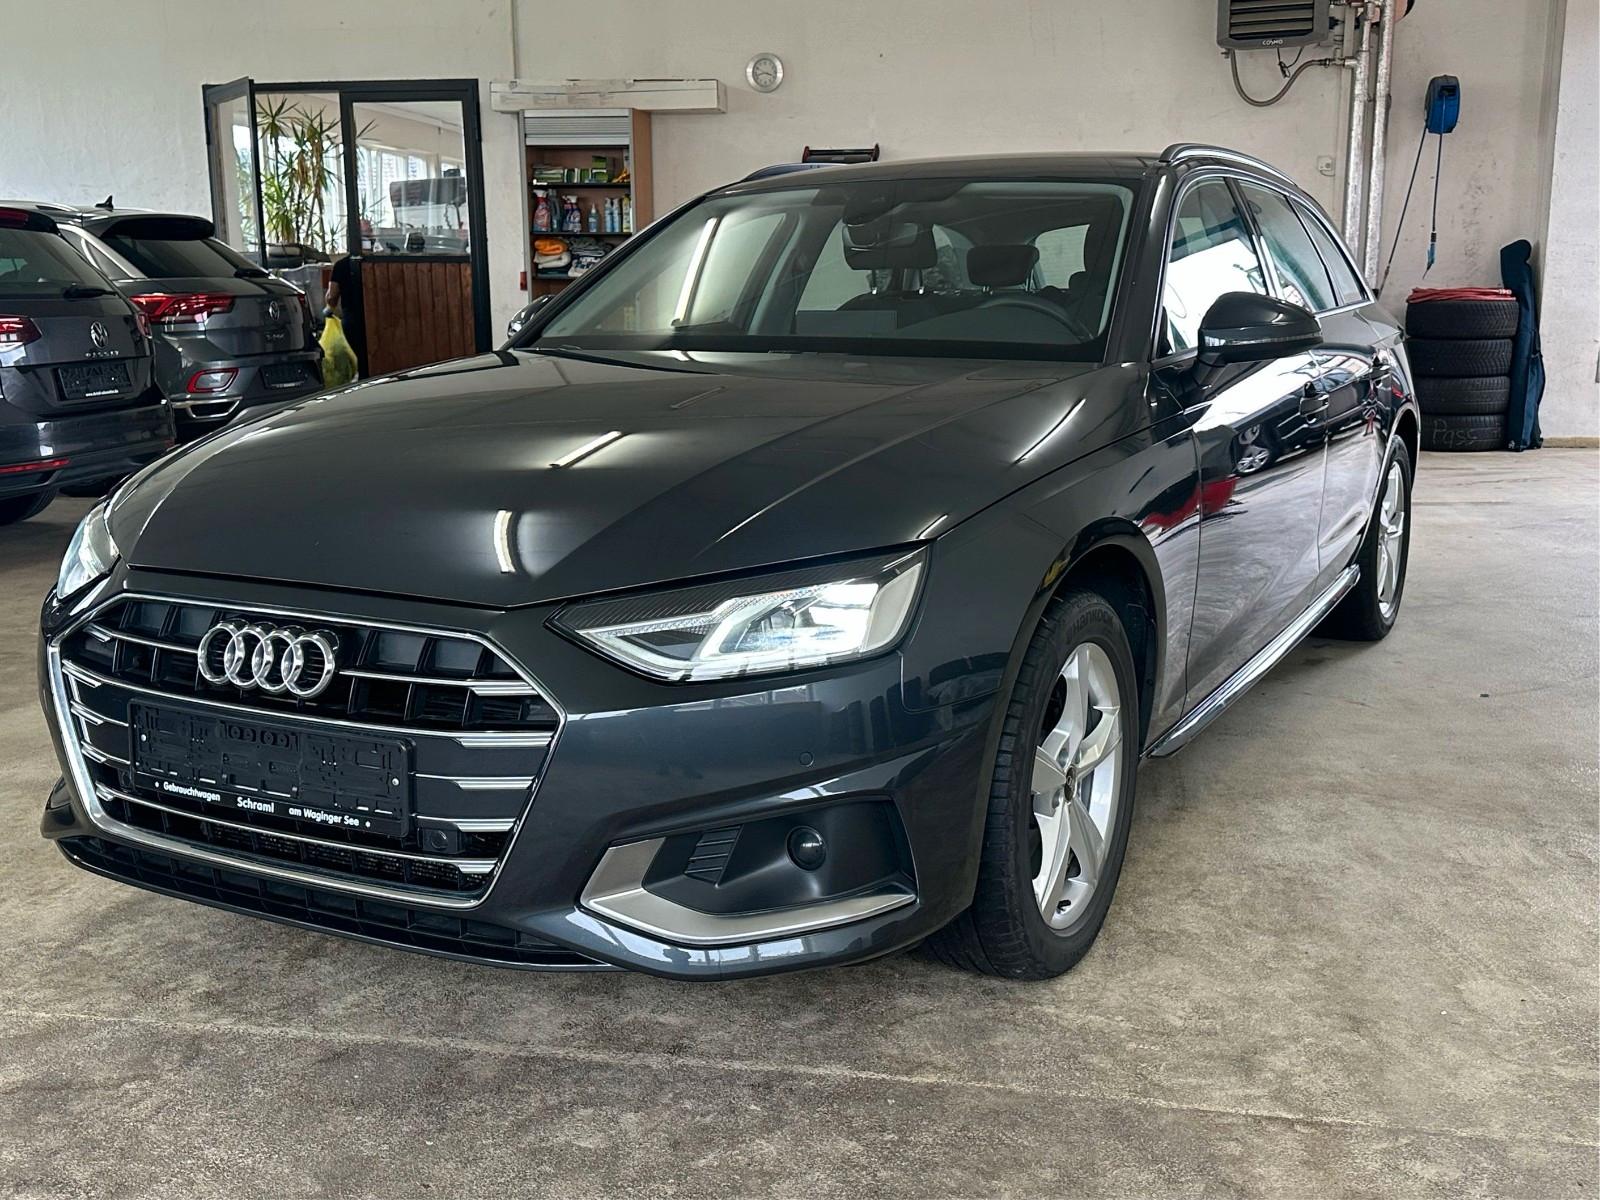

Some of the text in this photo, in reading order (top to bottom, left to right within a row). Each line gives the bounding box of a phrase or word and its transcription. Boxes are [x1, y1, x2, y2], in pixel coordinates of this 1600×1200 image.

[163, 781, 360, 827] Gebrauchtwagen Schraml am Waginger See
